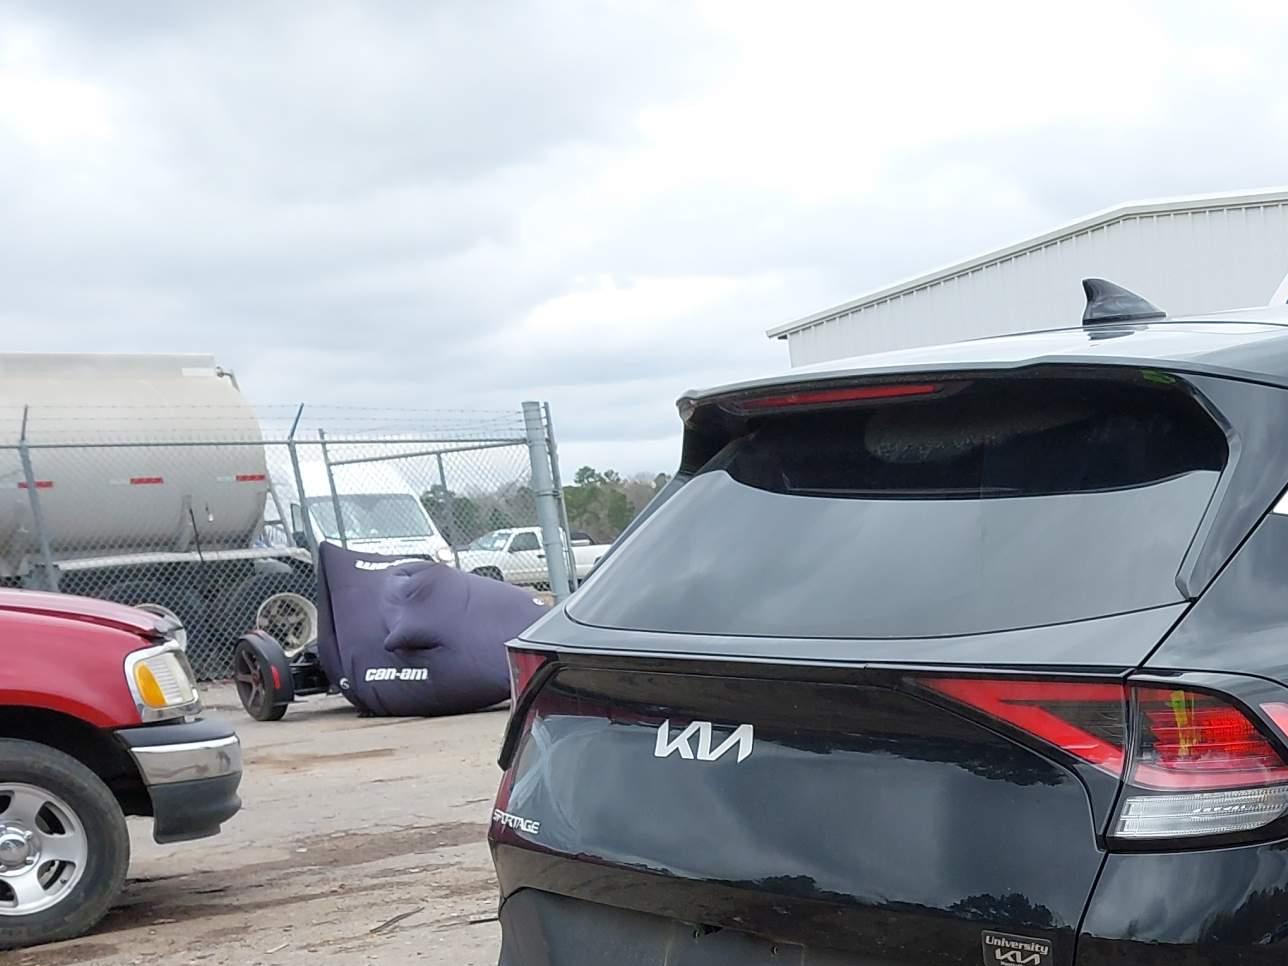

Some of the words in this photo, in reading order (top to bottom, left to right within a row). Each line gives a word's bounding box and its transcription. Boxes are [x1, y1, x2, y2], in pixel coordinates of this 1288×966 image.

[365, 668, 428, 682] can-am
[654, 719, 753, 763] KIA
[493, 808, 540, 834] SPORTAGE
[985, 935, 1049, 955] University
[995, 948, 1040, 966] KIA
